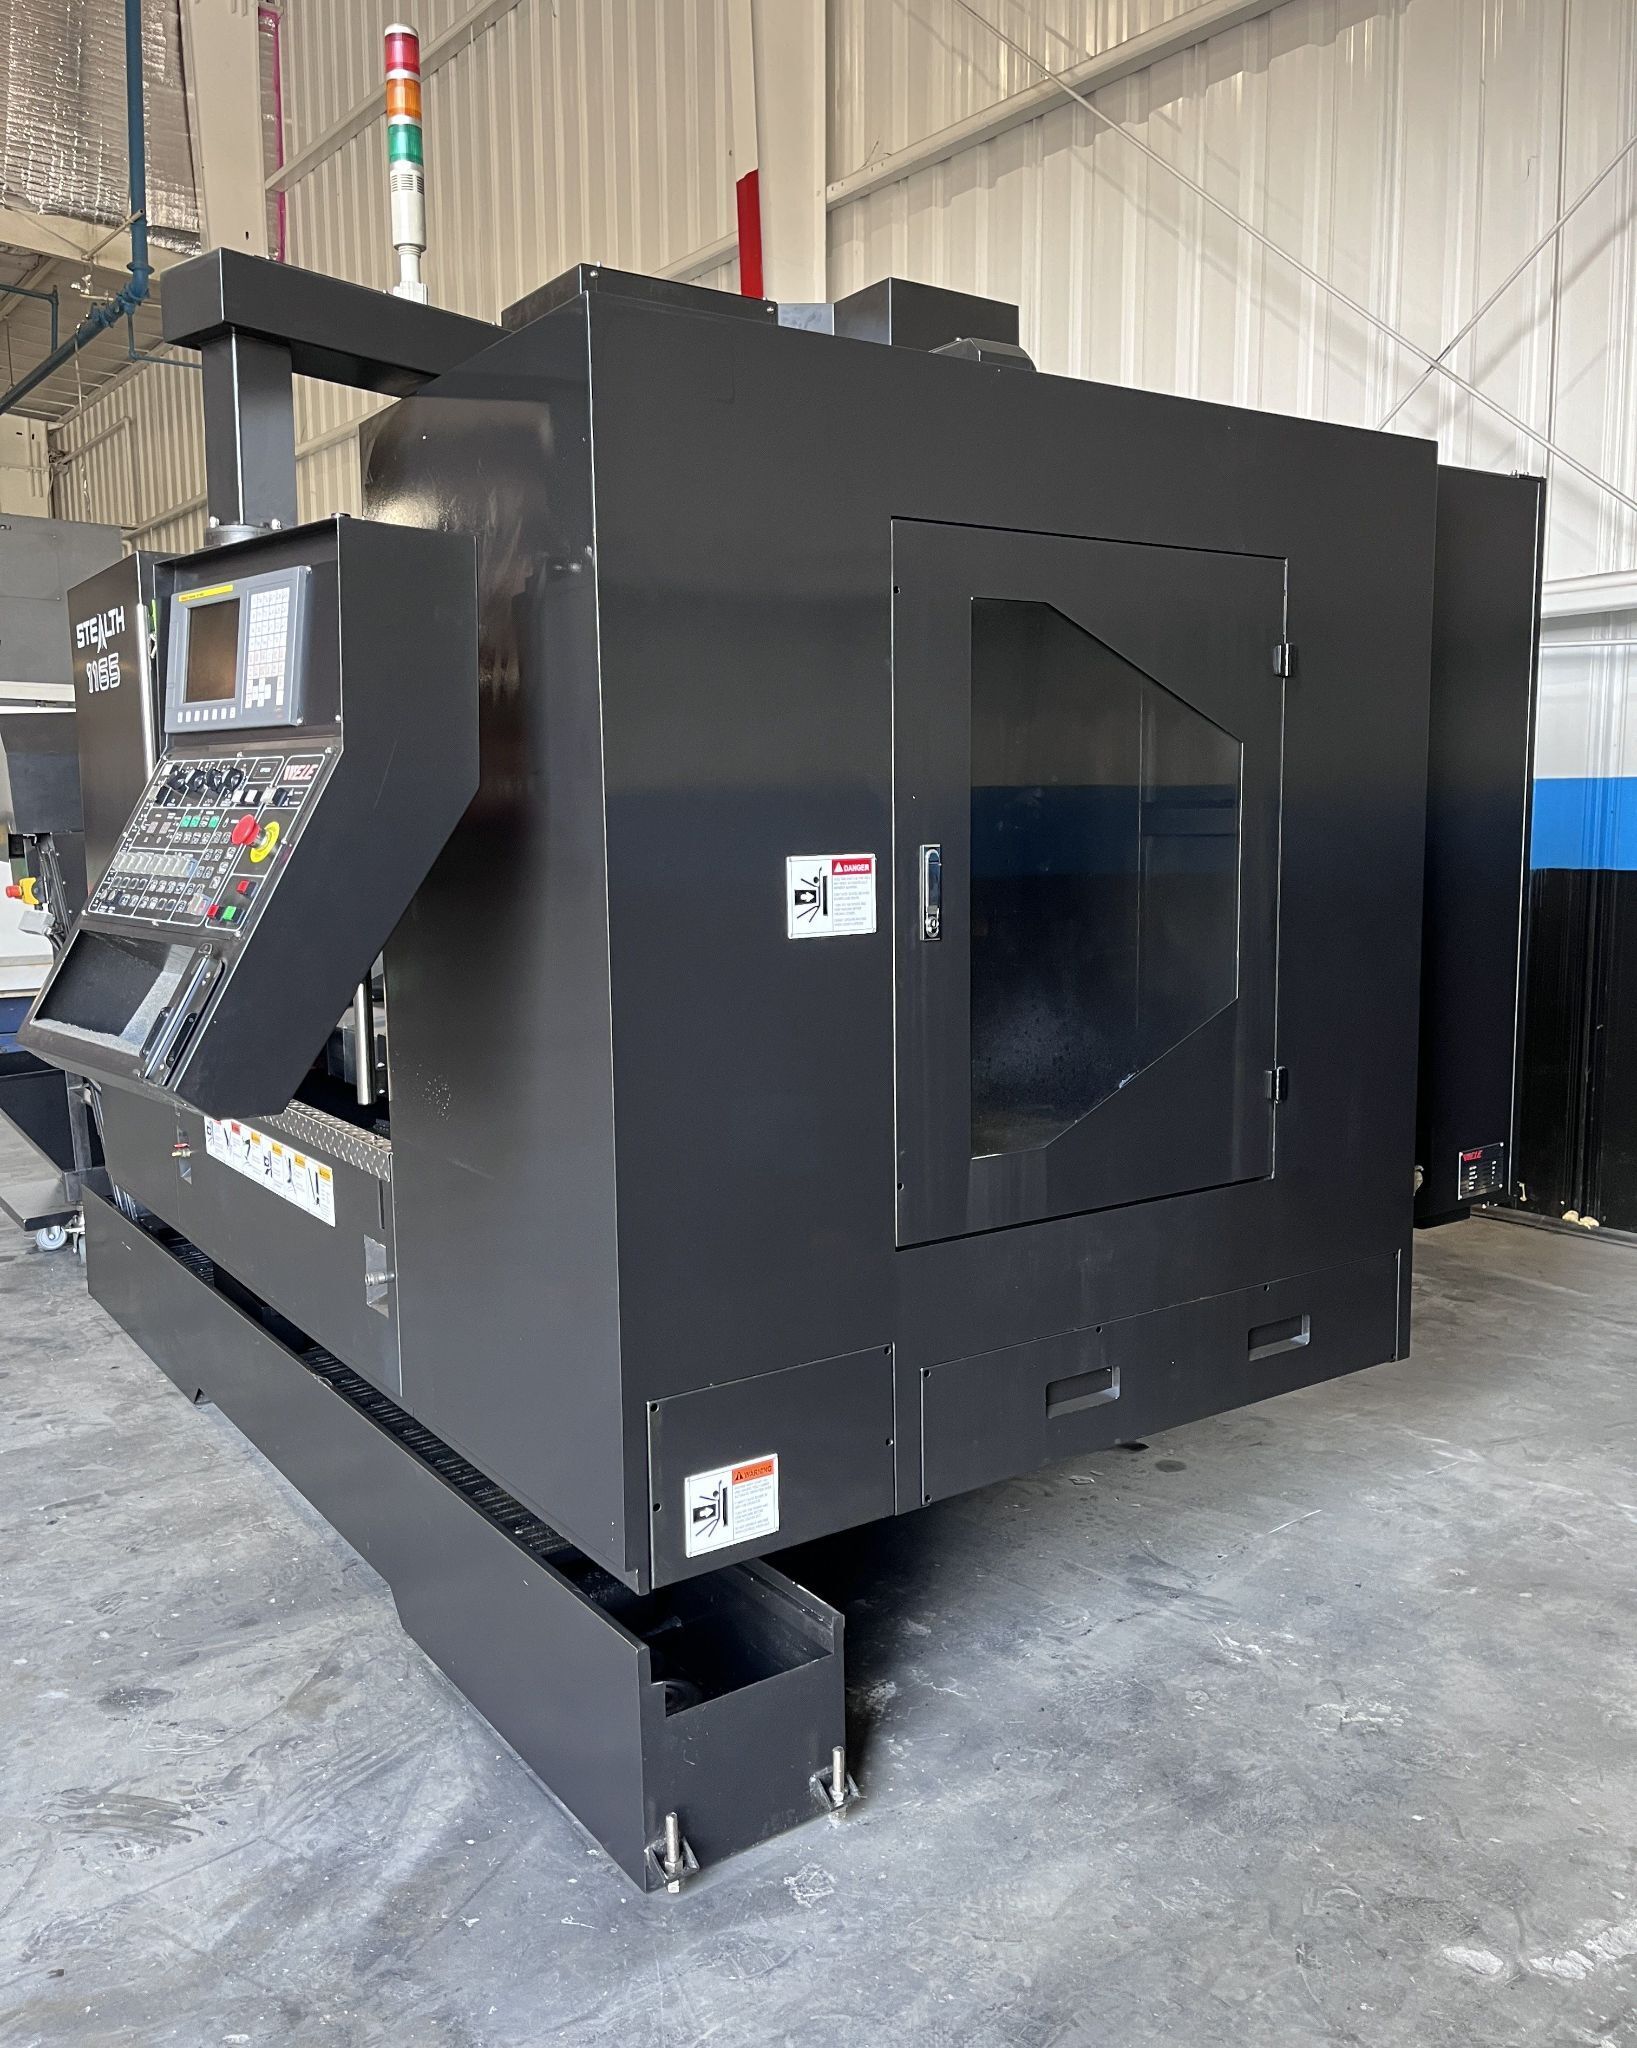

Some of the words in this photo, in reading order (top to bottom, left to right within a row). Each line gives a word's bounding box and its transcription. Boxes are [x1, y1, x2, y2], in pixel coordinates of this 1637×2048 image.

[76, 606, 125, 653] STEALTH
[86, 653, 121, 693] 1165
[283, 764, 319, 781] WELE
[843, 863, 870, 872] DANGER
[743, 1465, 772, 1478] WARNING
